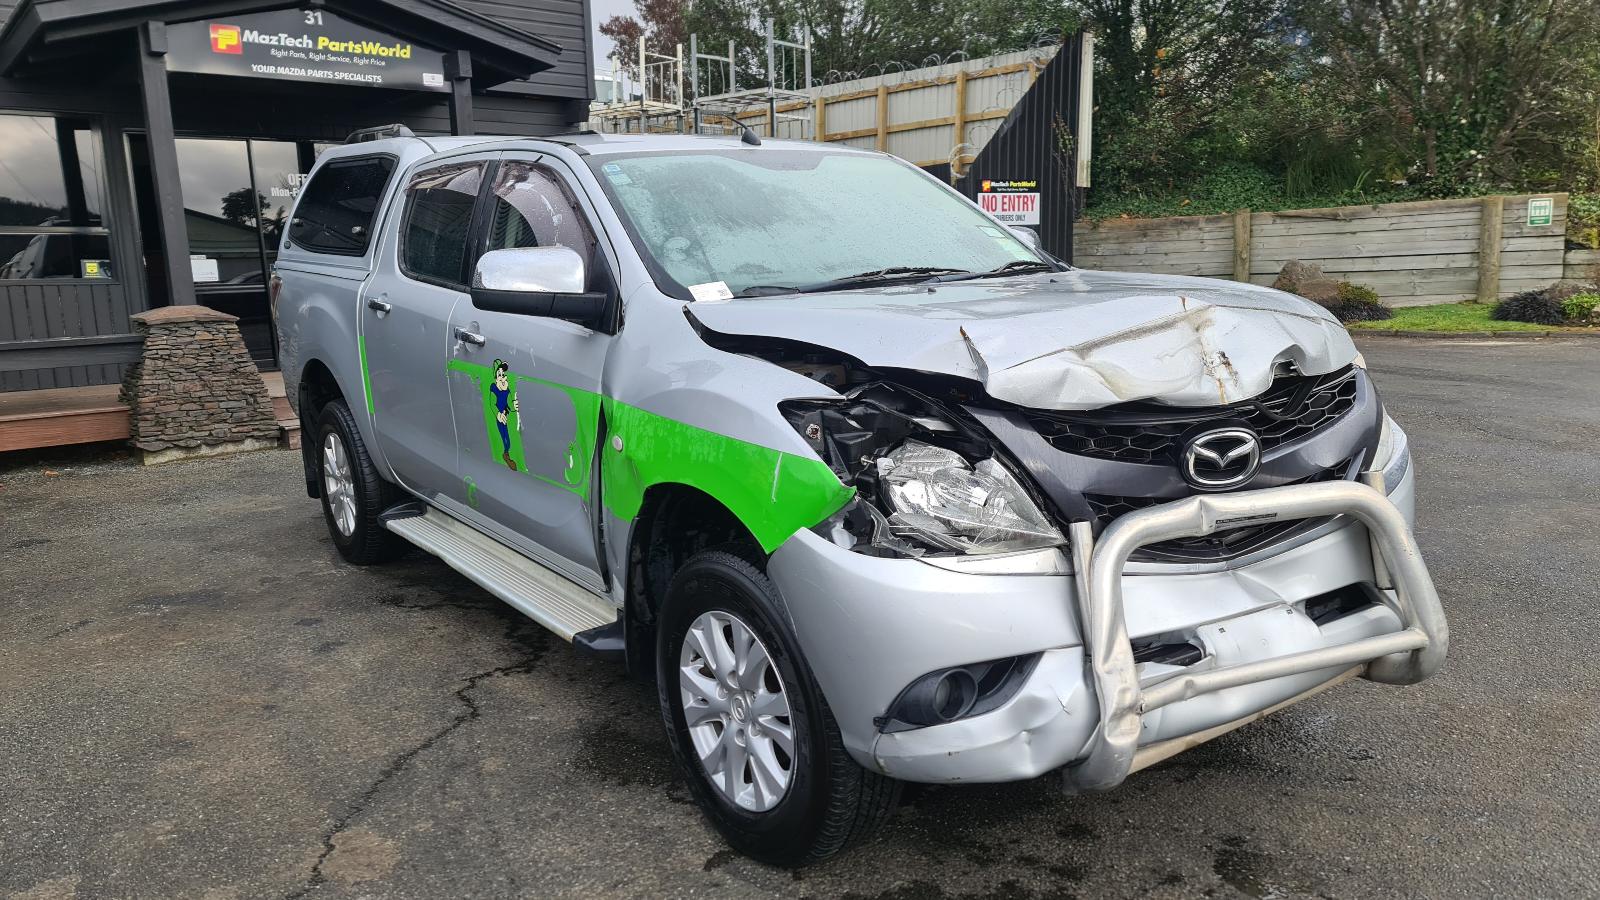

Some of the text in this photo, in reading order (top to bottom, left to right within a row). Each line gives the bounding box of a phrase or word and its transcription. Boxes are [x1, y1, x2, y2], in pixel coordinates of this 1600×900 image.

[304, 10, 323, 25] 31
[242, 29, 411, 59] MazTech PartsWorld
[270, 48, 288, 58] Right
[289, 50, 307, 60] Parts,
[309, 51, 326, 62] Right
[327, 54, 352, 64] Service,
[353, 56, 370, 66] Right
[251, 63, 382, 83] YOUR MAZDA PARTS SPECIALISTS
[982, 194, 1036, 212] NO ENTRY
